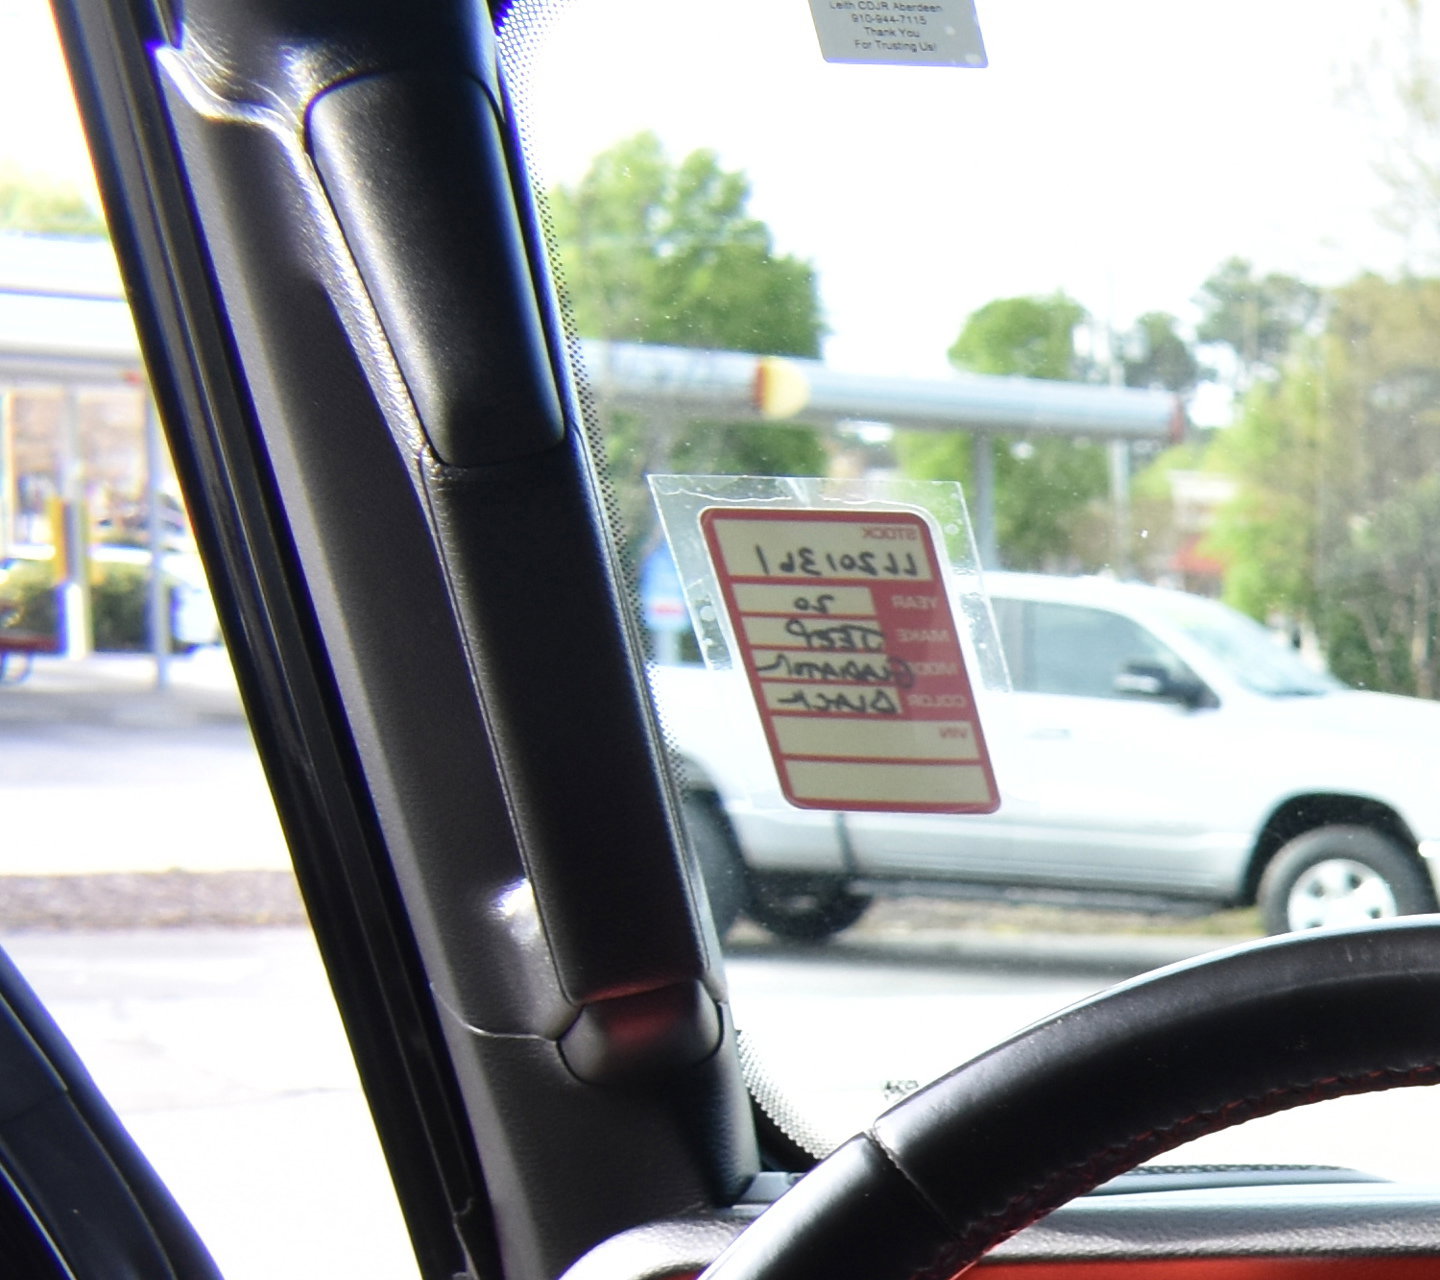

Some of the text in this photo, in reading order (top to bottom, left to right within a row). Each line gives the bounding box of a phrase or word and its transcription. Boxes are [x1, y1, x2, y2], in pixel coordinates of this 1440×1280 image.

[893, 3, 943, 12] Aberdeen
[851, 13, 927, 25] 910-944-7115
[864, 26, 920, 38] Thank You
[855, 40, 871, 49] For
[876, 40, 917, 52] Trusting
